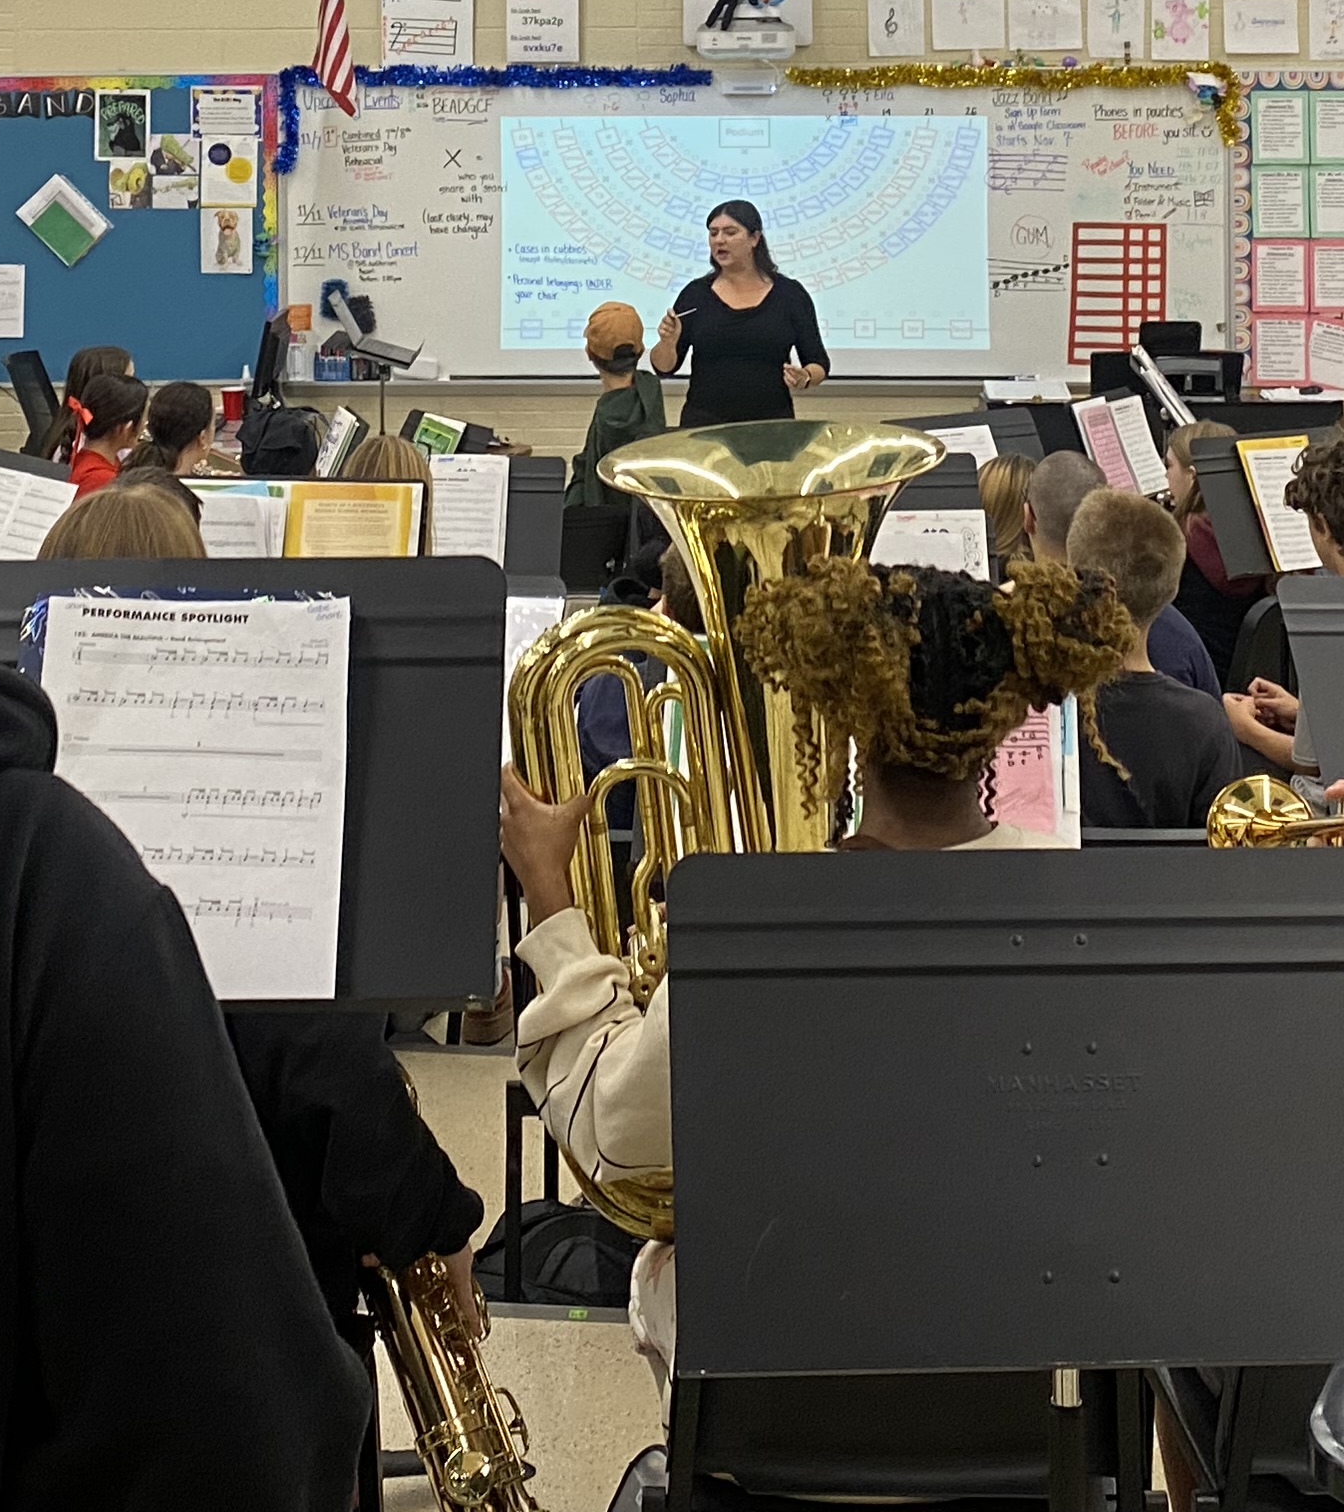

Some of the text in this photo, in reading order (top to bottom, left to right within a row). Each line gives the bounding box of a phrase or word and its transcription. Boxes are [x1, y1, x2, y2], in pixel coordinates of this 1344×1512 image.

[522, 16, 564, 27] 37kpa2p
[523, 43, 563, 53] svxku7e
[992, 88, 1053, 105] Jazz Band
[1092, 104, 1184, 118] Phones in pouches
[996, 134, 1028, 146] Starts
[1063, 131, 1073, 147] 7
[1113, 124, 1158, 140] BEFORE
[1163, 129, 1180, 145] you
[383, 142, 397, 156] Day
[1148, 161, 1175, 176] NEED
[480, 173, 494, 185] you
[461, 194, 483, 204] with
[372, 205, 388, 223] Day
[476, 214, 494, 226] may
[1016, 225, 1050, 246] GUM
[328, 244, 350, 260] MS
[515, 244, 540, 254] Cases
[541, 244, 550, 254] in
[513, 275, 544, 286] Personal
[546, 276, 583, 294] belongings
[515, 291, 558, 303] your chair
[81, 607, 250, 625] PERFORMANCE SPOTLIGHT
